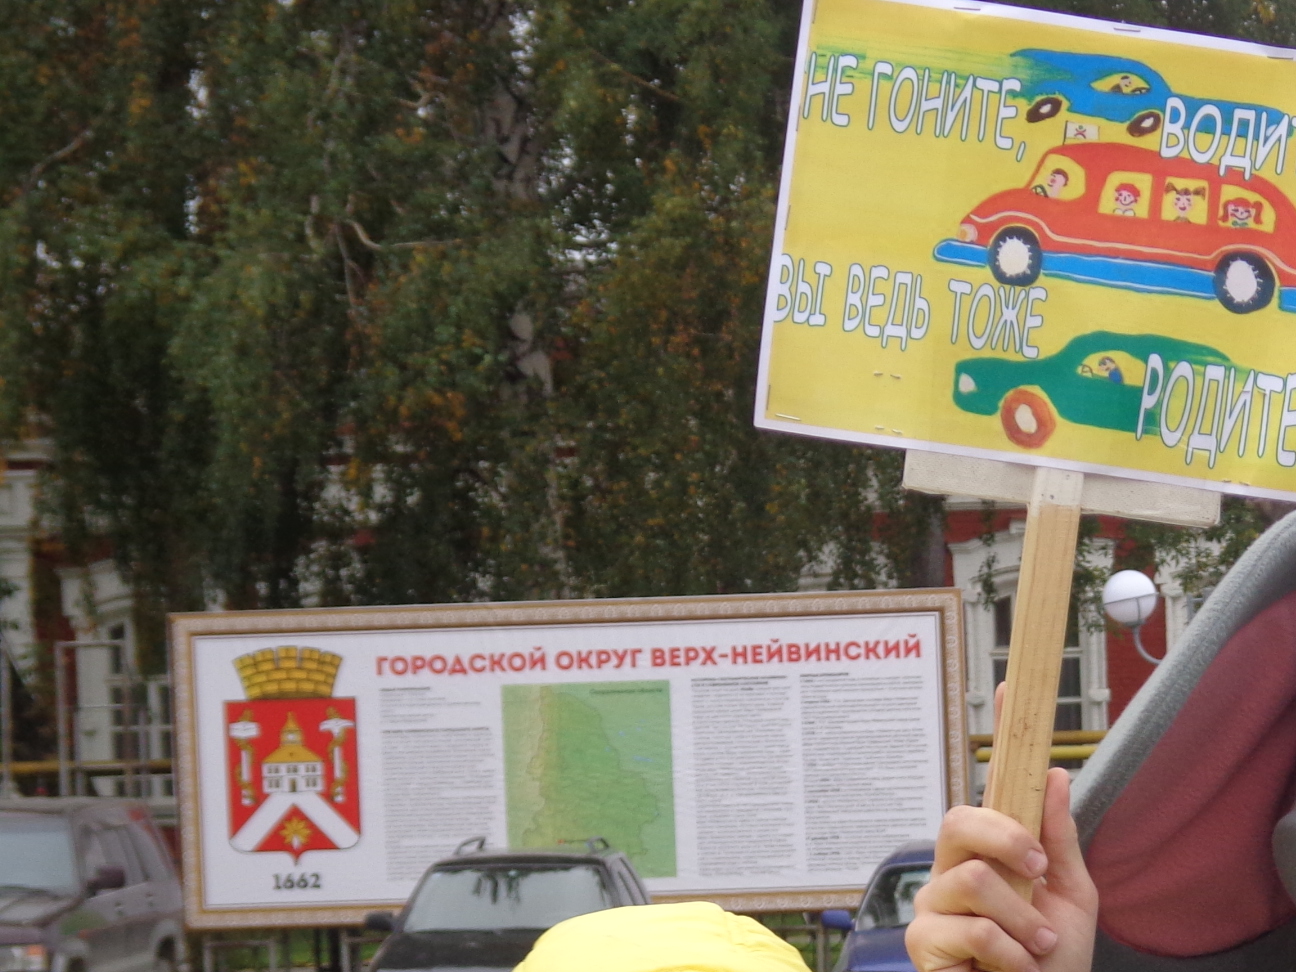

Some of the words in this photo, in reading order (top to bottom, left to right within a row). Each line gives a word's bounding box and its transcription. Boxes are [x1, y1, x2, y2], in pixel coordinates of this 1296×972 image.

[802, 51, 859, 127] НЕ
[867, 60, 1026, 163] ГОНИТЕ,
[773, 253, 833, 327] ВЫ
[842, 262, 931, 352] ВЕДЬ
[947, 277, 1048, 360] ТОЖЕ
[375, 646, 547, 677] ГОРОДСКОЙ
[554, 648, 643, 671] ОКРУГ
[651, 633, 922, 667] ВЕРХ-НЕЙВИНСКИЙ
[271, 872, 321, 890] 1662
